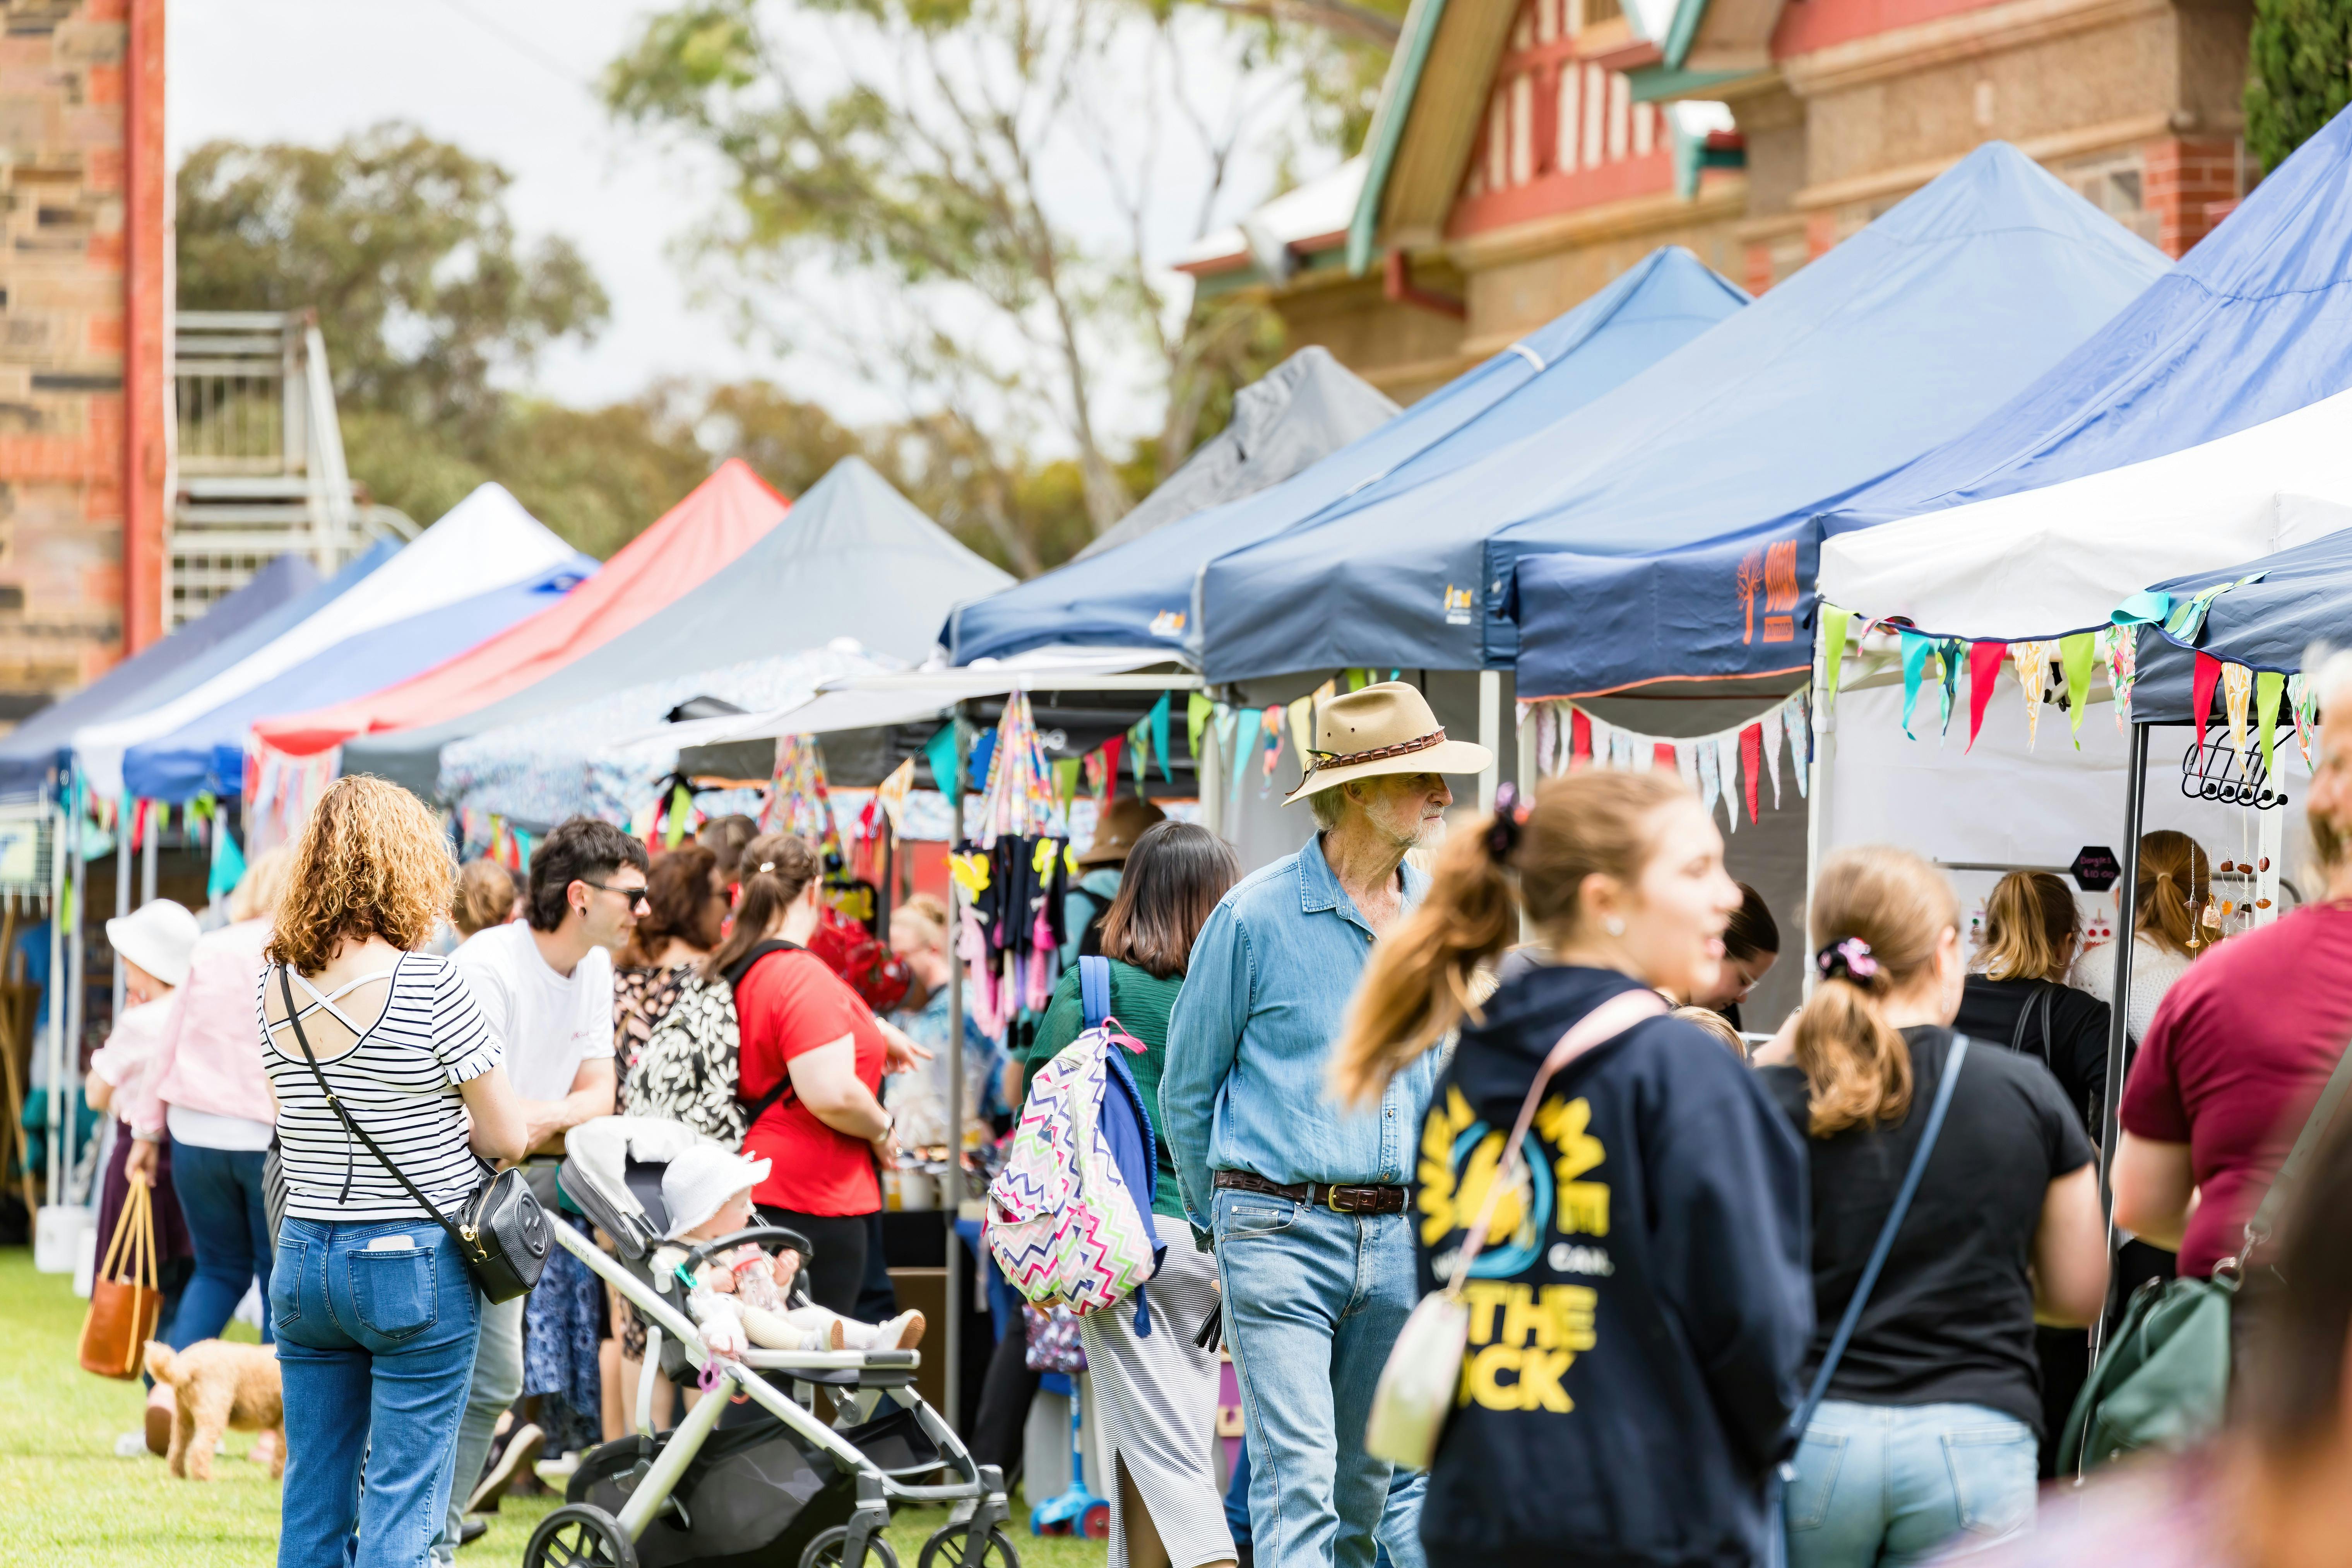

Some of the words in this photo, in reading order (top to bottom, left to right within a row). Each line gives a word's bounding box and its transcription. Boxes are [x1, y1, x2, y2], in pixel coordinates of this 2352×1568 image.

[565, 1236, 589, 1262] VISTA
[1461, 1279, 1598, 1352] THE
[1458, 1344, 1576, 1414] CK
